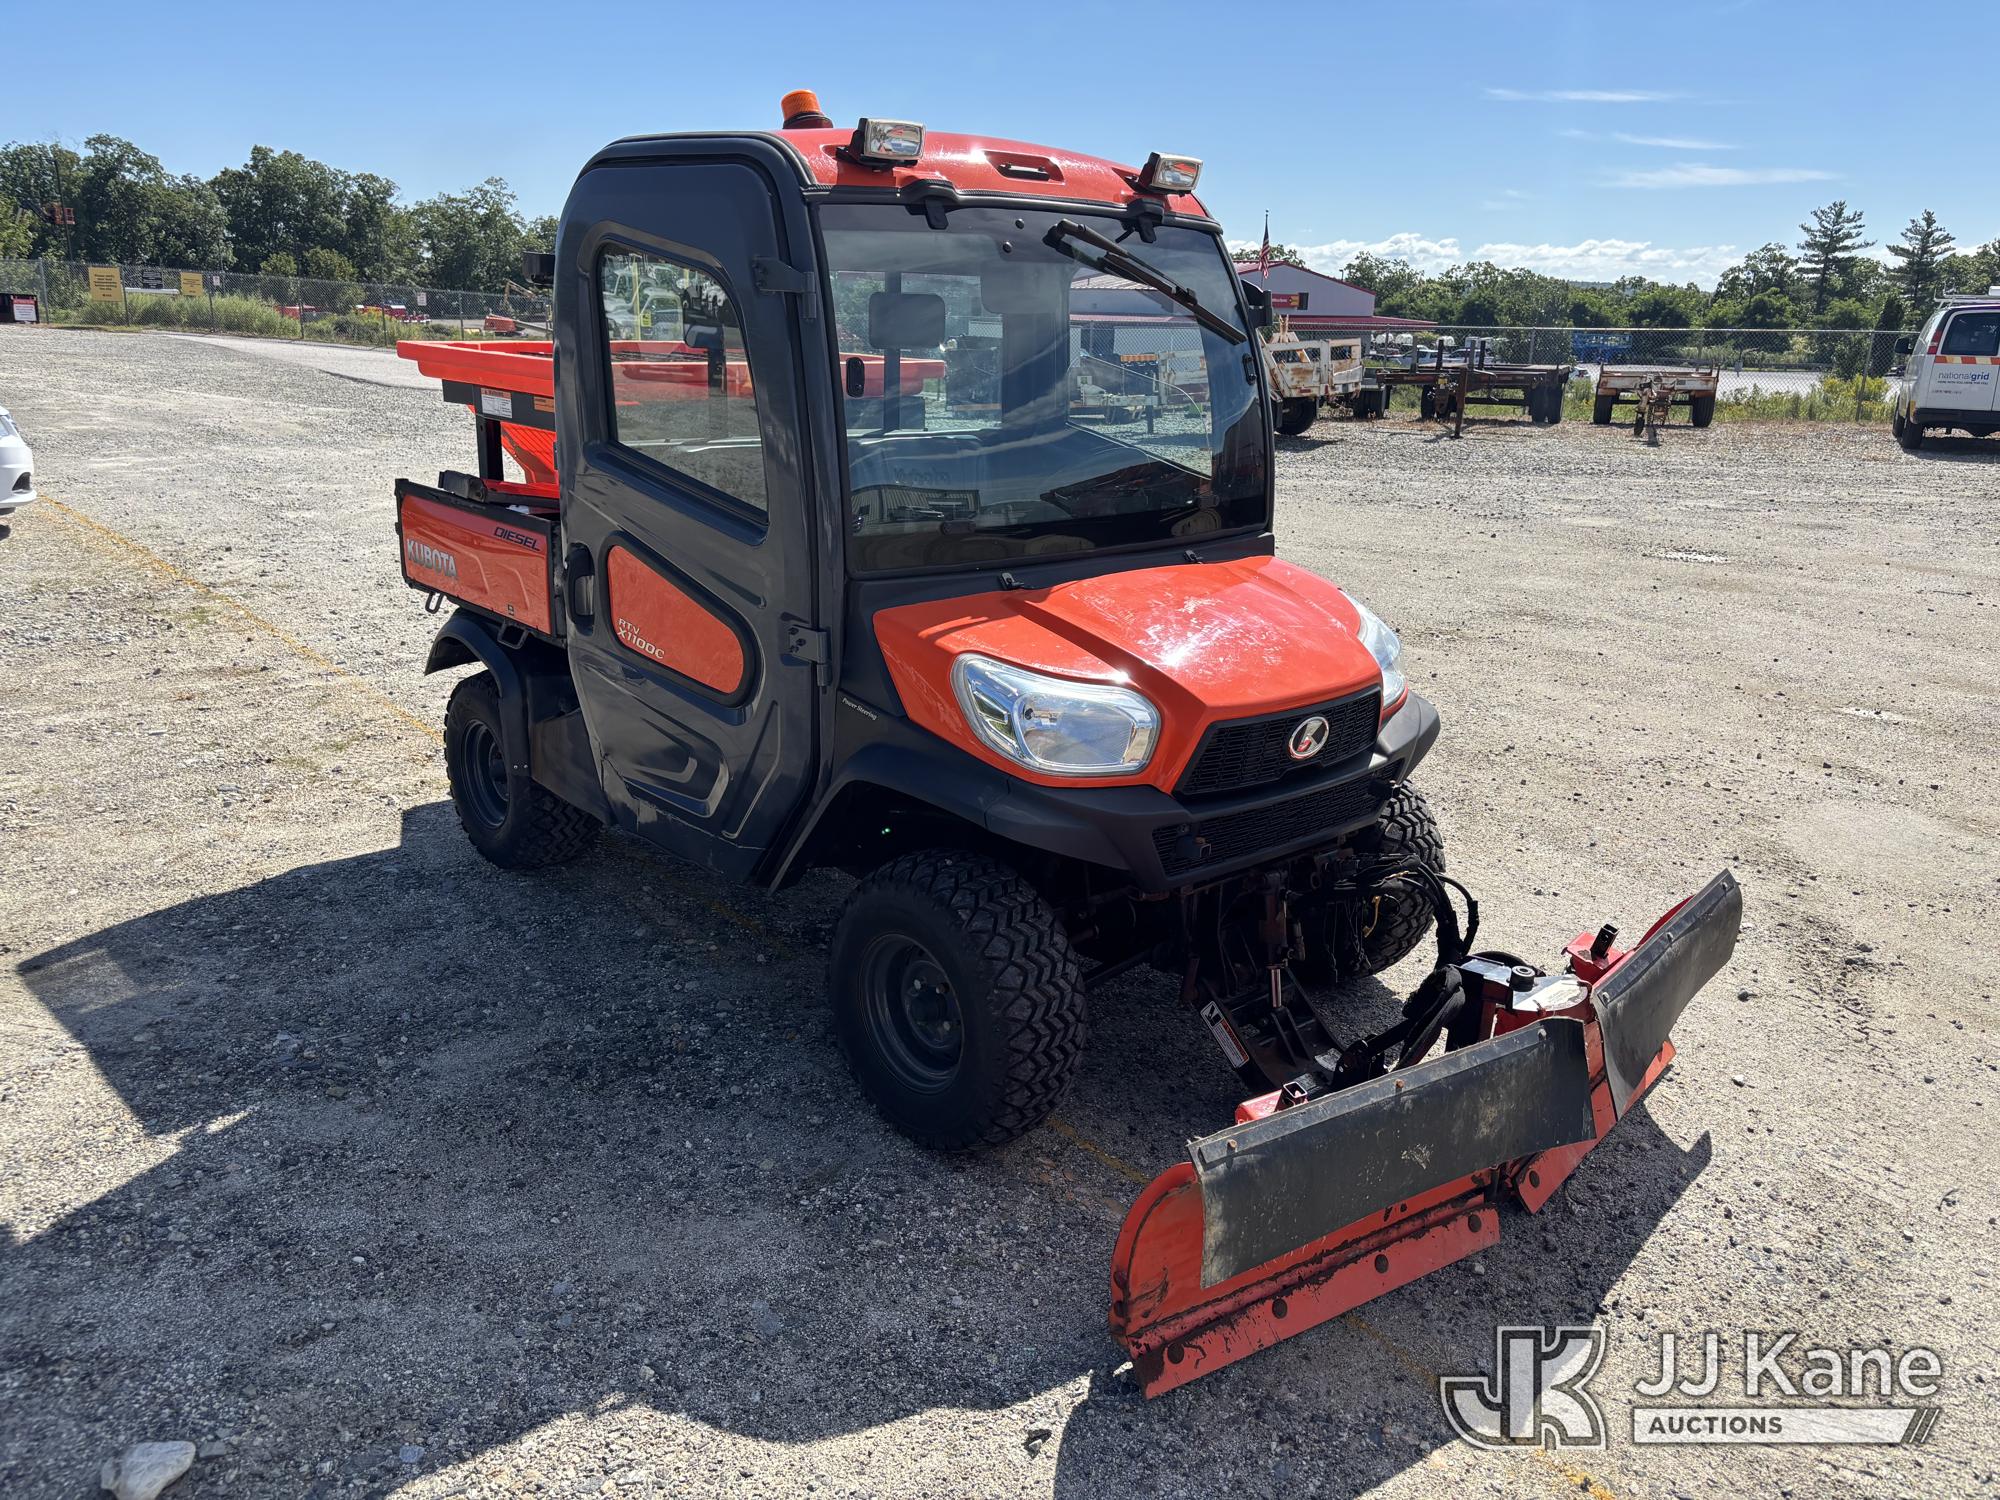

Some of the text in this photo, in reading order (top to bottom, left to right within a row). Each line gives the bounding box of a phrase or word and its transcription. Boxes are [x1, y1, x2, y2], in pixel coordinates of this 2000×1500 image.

[1938, 372, 1990, 381] nationalgrid
[494, 526, 541, 552] DIESEL
[406, 538, 458, 577] KUBOTA
[618, 617, 640, 635] RTV
[617, 626, 665, 659] X1100C
